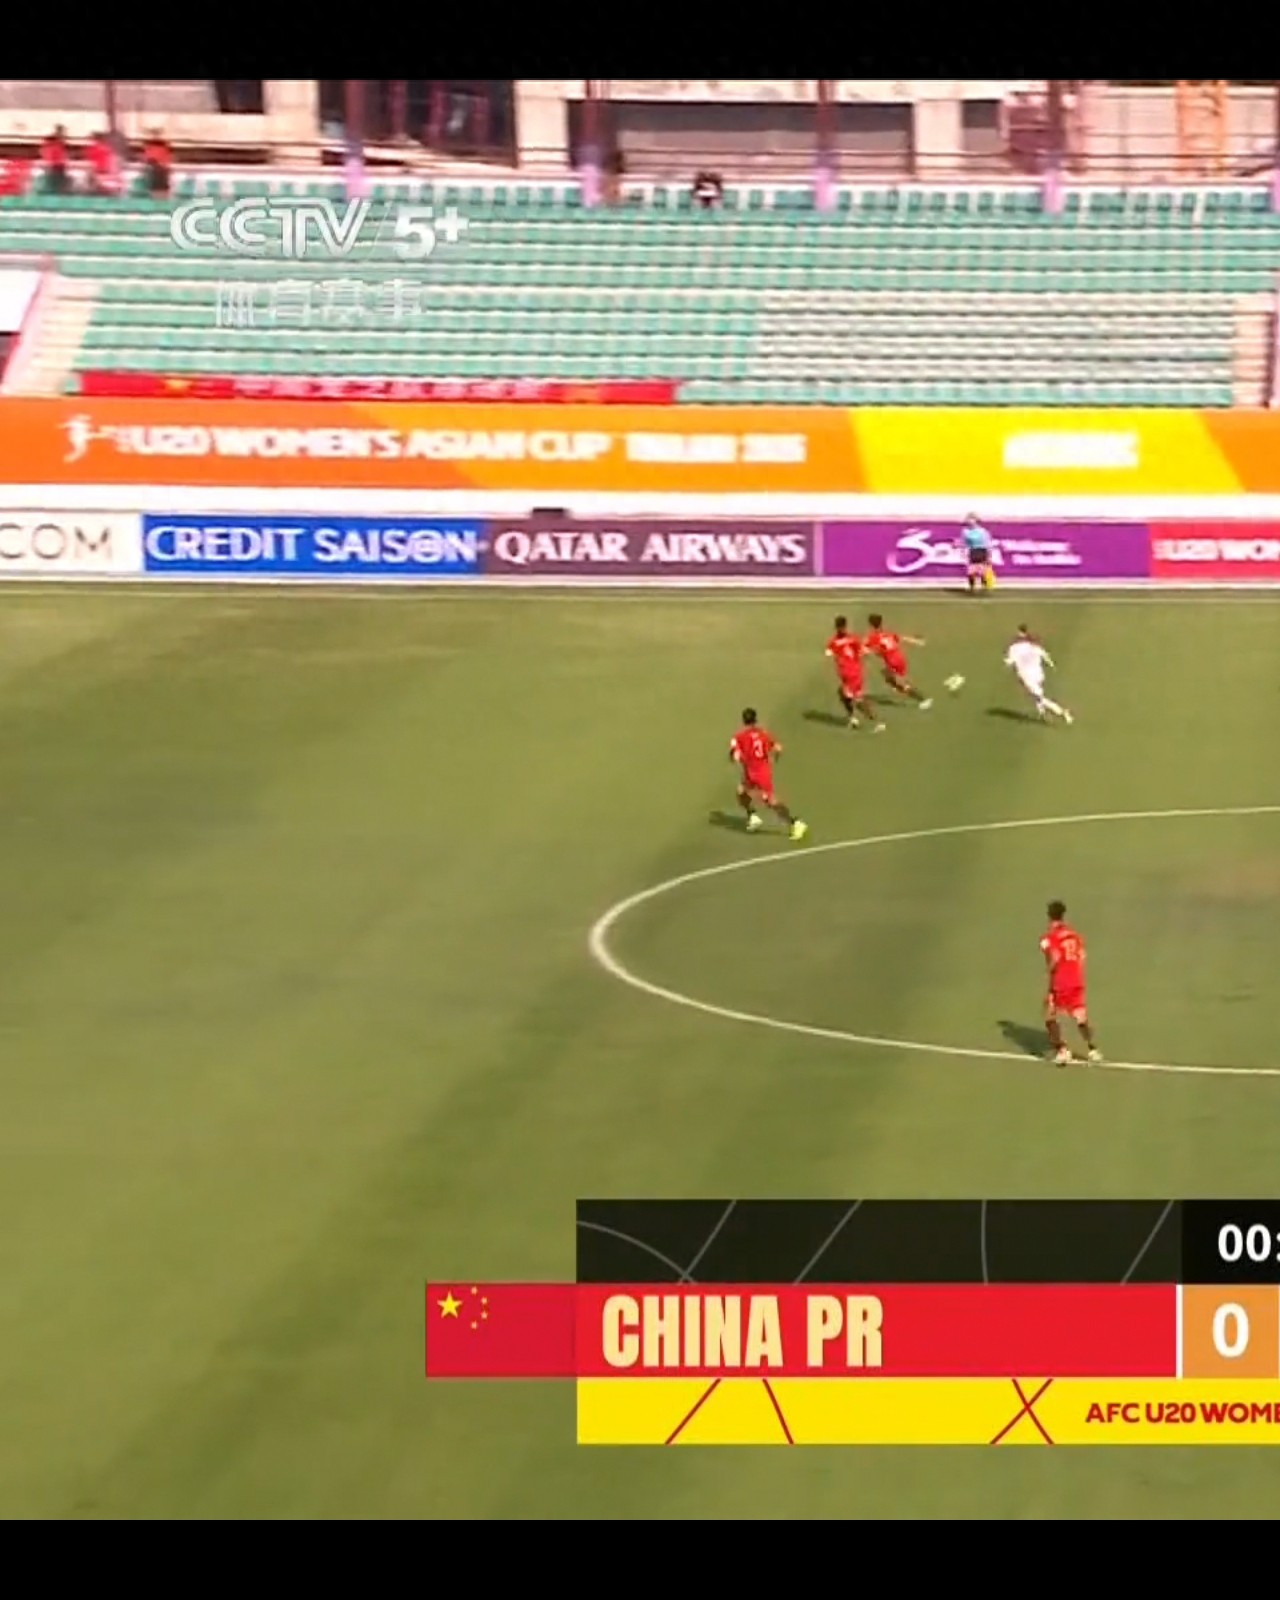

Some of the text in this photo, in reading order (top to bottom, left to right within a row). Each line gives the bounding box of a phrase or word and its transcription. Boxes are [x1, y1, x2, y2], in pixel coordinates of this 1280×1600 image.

[403, 430, 525, 461] ASIAN
[528, 431, 611, 461] CUP
[145, 525, 477, 563] CREDIT SAISON
[494, 531, 807, 565] QATAR AIRWAYS
